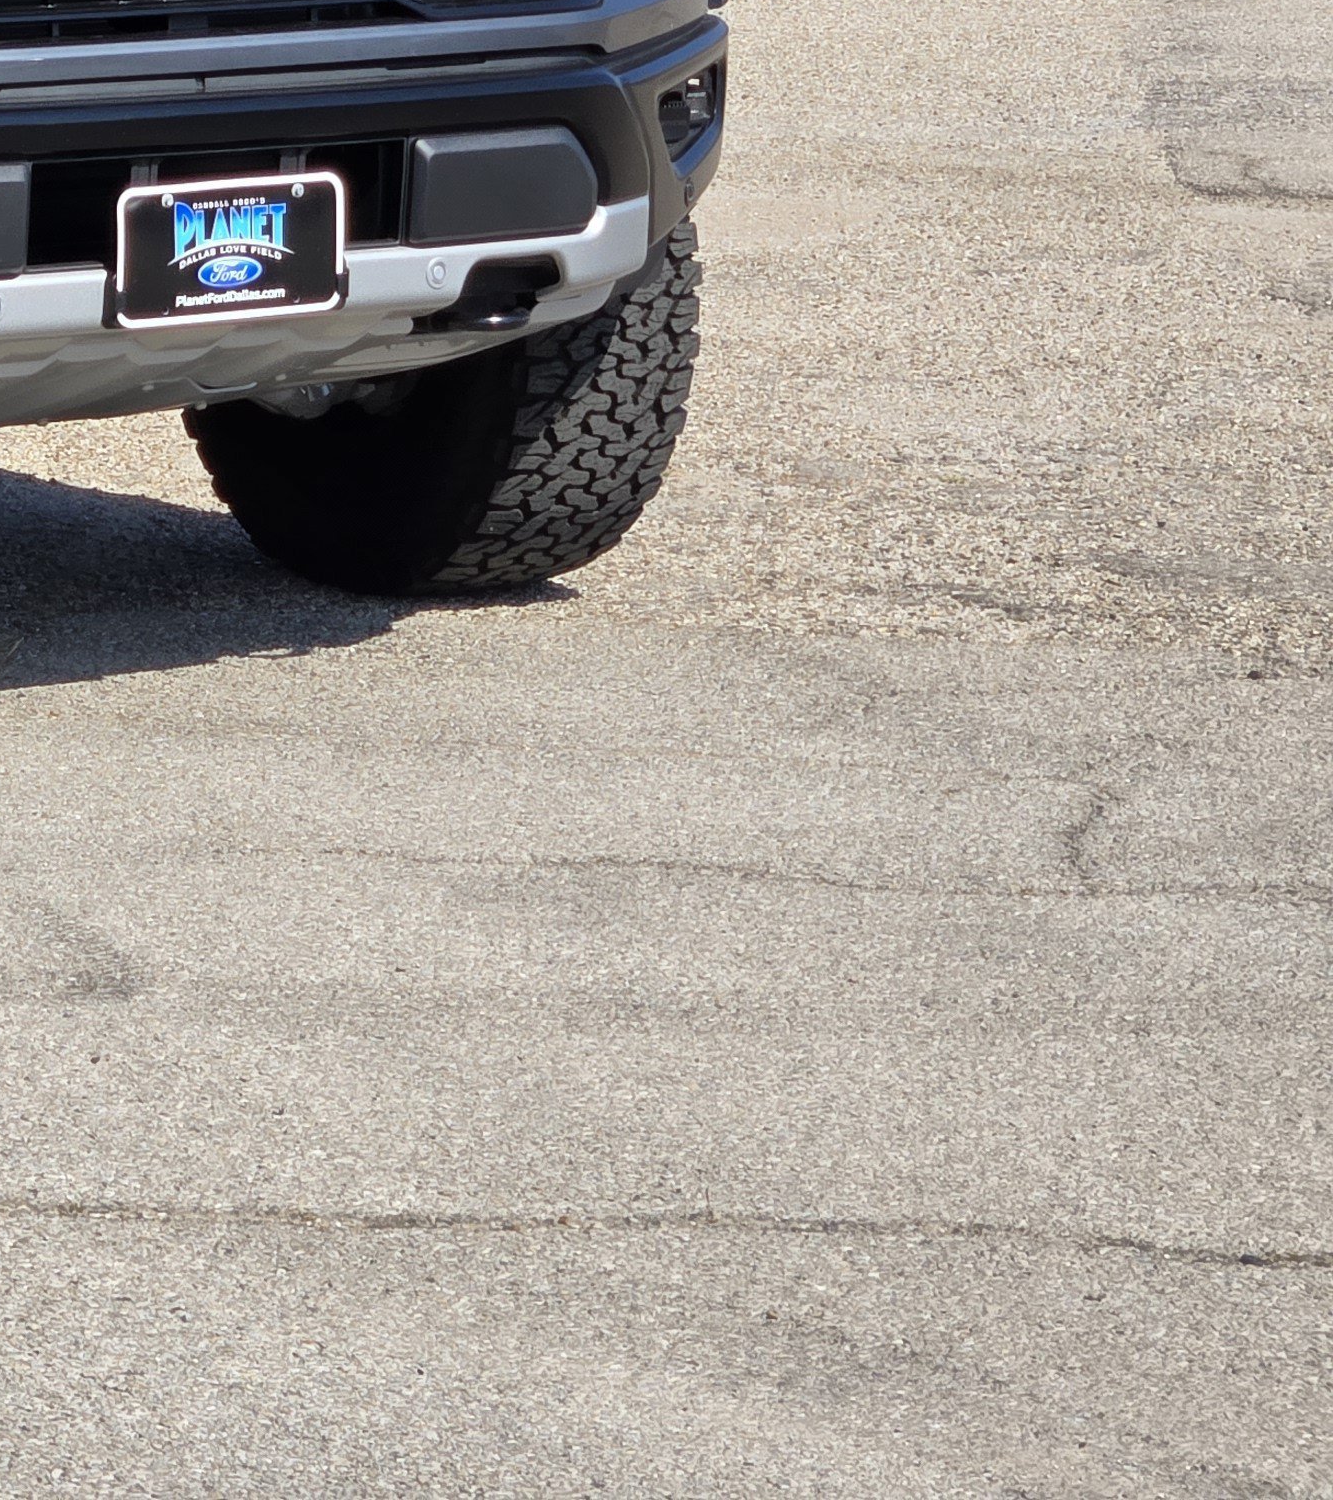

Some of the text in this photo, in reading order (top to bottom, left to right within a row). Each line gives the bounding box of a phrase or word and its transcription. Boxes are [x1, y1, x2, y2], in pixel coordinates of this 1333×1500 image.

[173, 202, 287, 259] PLANET
[179, 245, 283, 270] DALLAS LOVE FIELD
[209, 260, 248, 283] Ford
[175, 288, 286, 308] PlanetFordDallas.com
